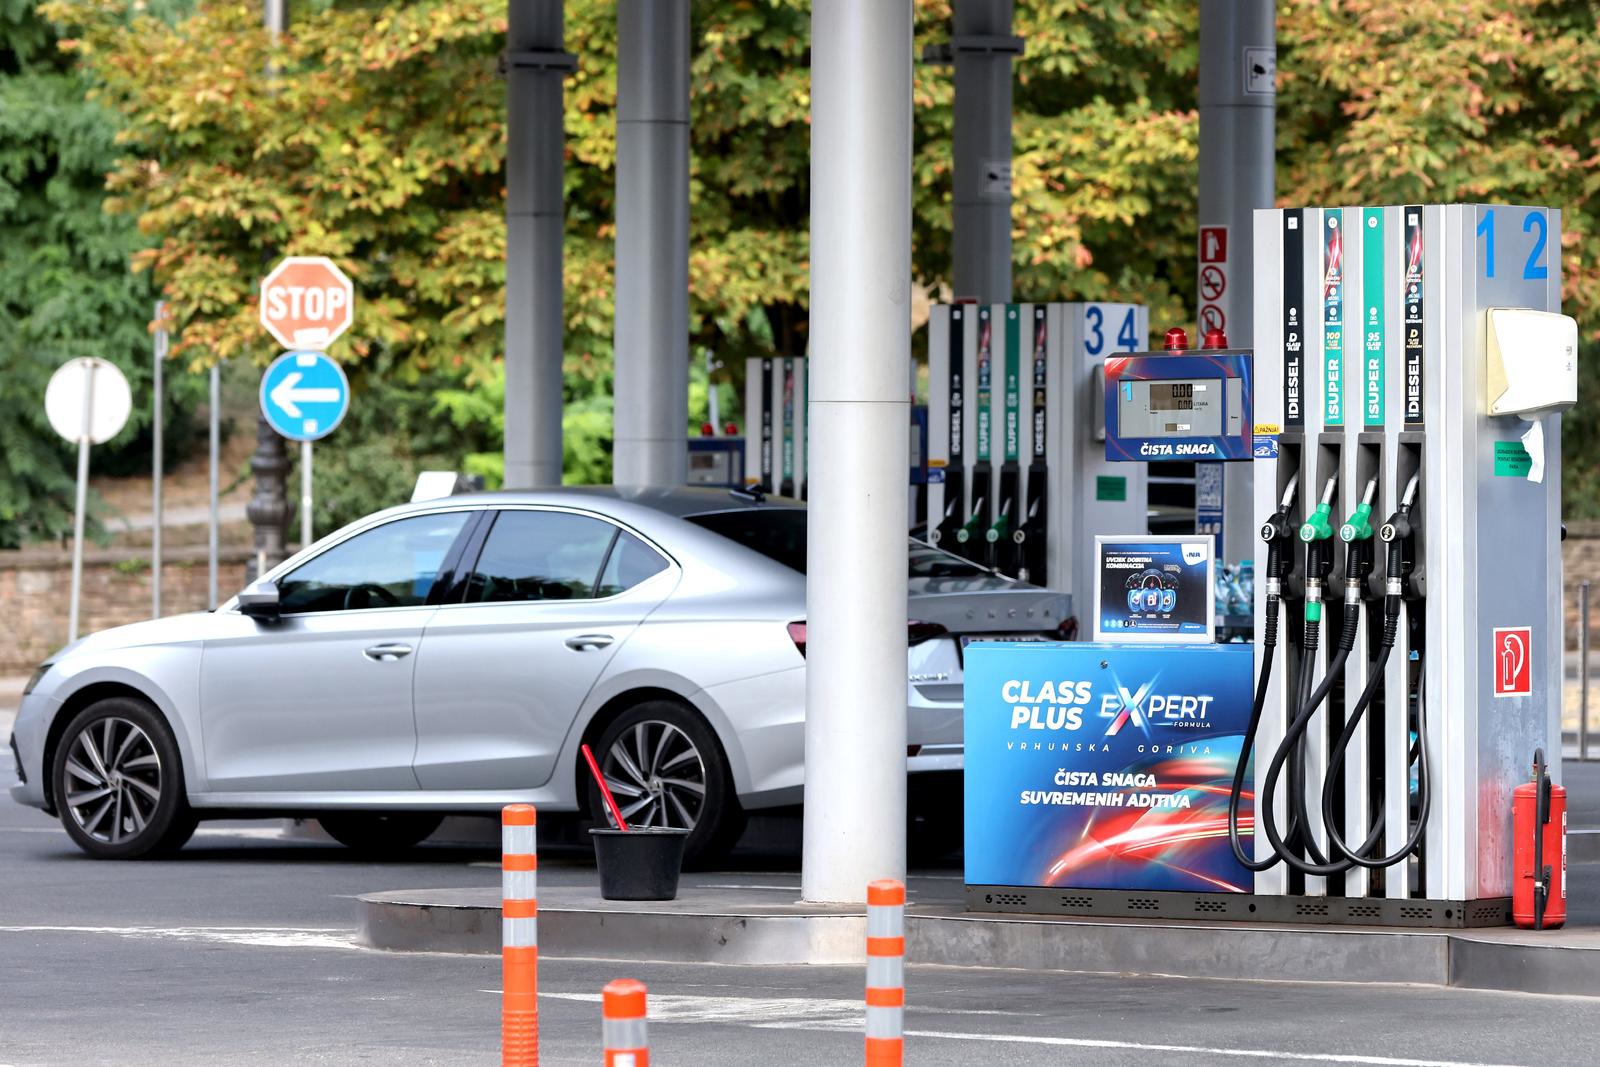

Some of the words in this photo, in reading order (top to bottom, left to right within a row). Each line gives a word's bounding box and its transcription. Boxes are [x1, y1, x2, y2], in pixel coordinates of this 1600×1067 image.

[1477, 209, 1494, 278] 1
[1523, 211, 1547, 279] 2
[268, 286, 345, 320] STOP
[1085, 306, 1104, 355] 3
[1118, 308, 1138, 352] 4
[1368, 332, 1380, 341] 95
[1410, 329, 1418, 338] D
[1122, 381, 1132, 400] 1
[1288, 357, 1298, 414] DIESEL
[1328, 359, 1339, 415] SUPER
[1369, 358, 1379, 415] SUPER
[1409, 355, 1419, 413] DIESEL
[952, 410, 961, 453] DIESEL
[979, 412, 988, 452] SUPER
[1008, 412, 1016, 452] SUPER
[1036, 410, 1044, 452] DIESEL
[1140, 442, 1172, 455] ČISTA
[1176, 444, 1215, 454] SNAGA
[1002, 680, 1092, 704] CLASS
[1101, 682, 1214, 736] EXPERT
[1011, 706, 1083, 730] PLUS
[1007, 742, 1110, 752] VRHUNSKA
[1138, 745, 1210, 754] GORIVA
[1054, 768, 1098, 786] ČISTA
[1102, 773, 1156, 788] SNAGA
[1020, 791, 1124, 806] SUVREMENIH
[1126, 793, 1191, 808] ADITIVA
